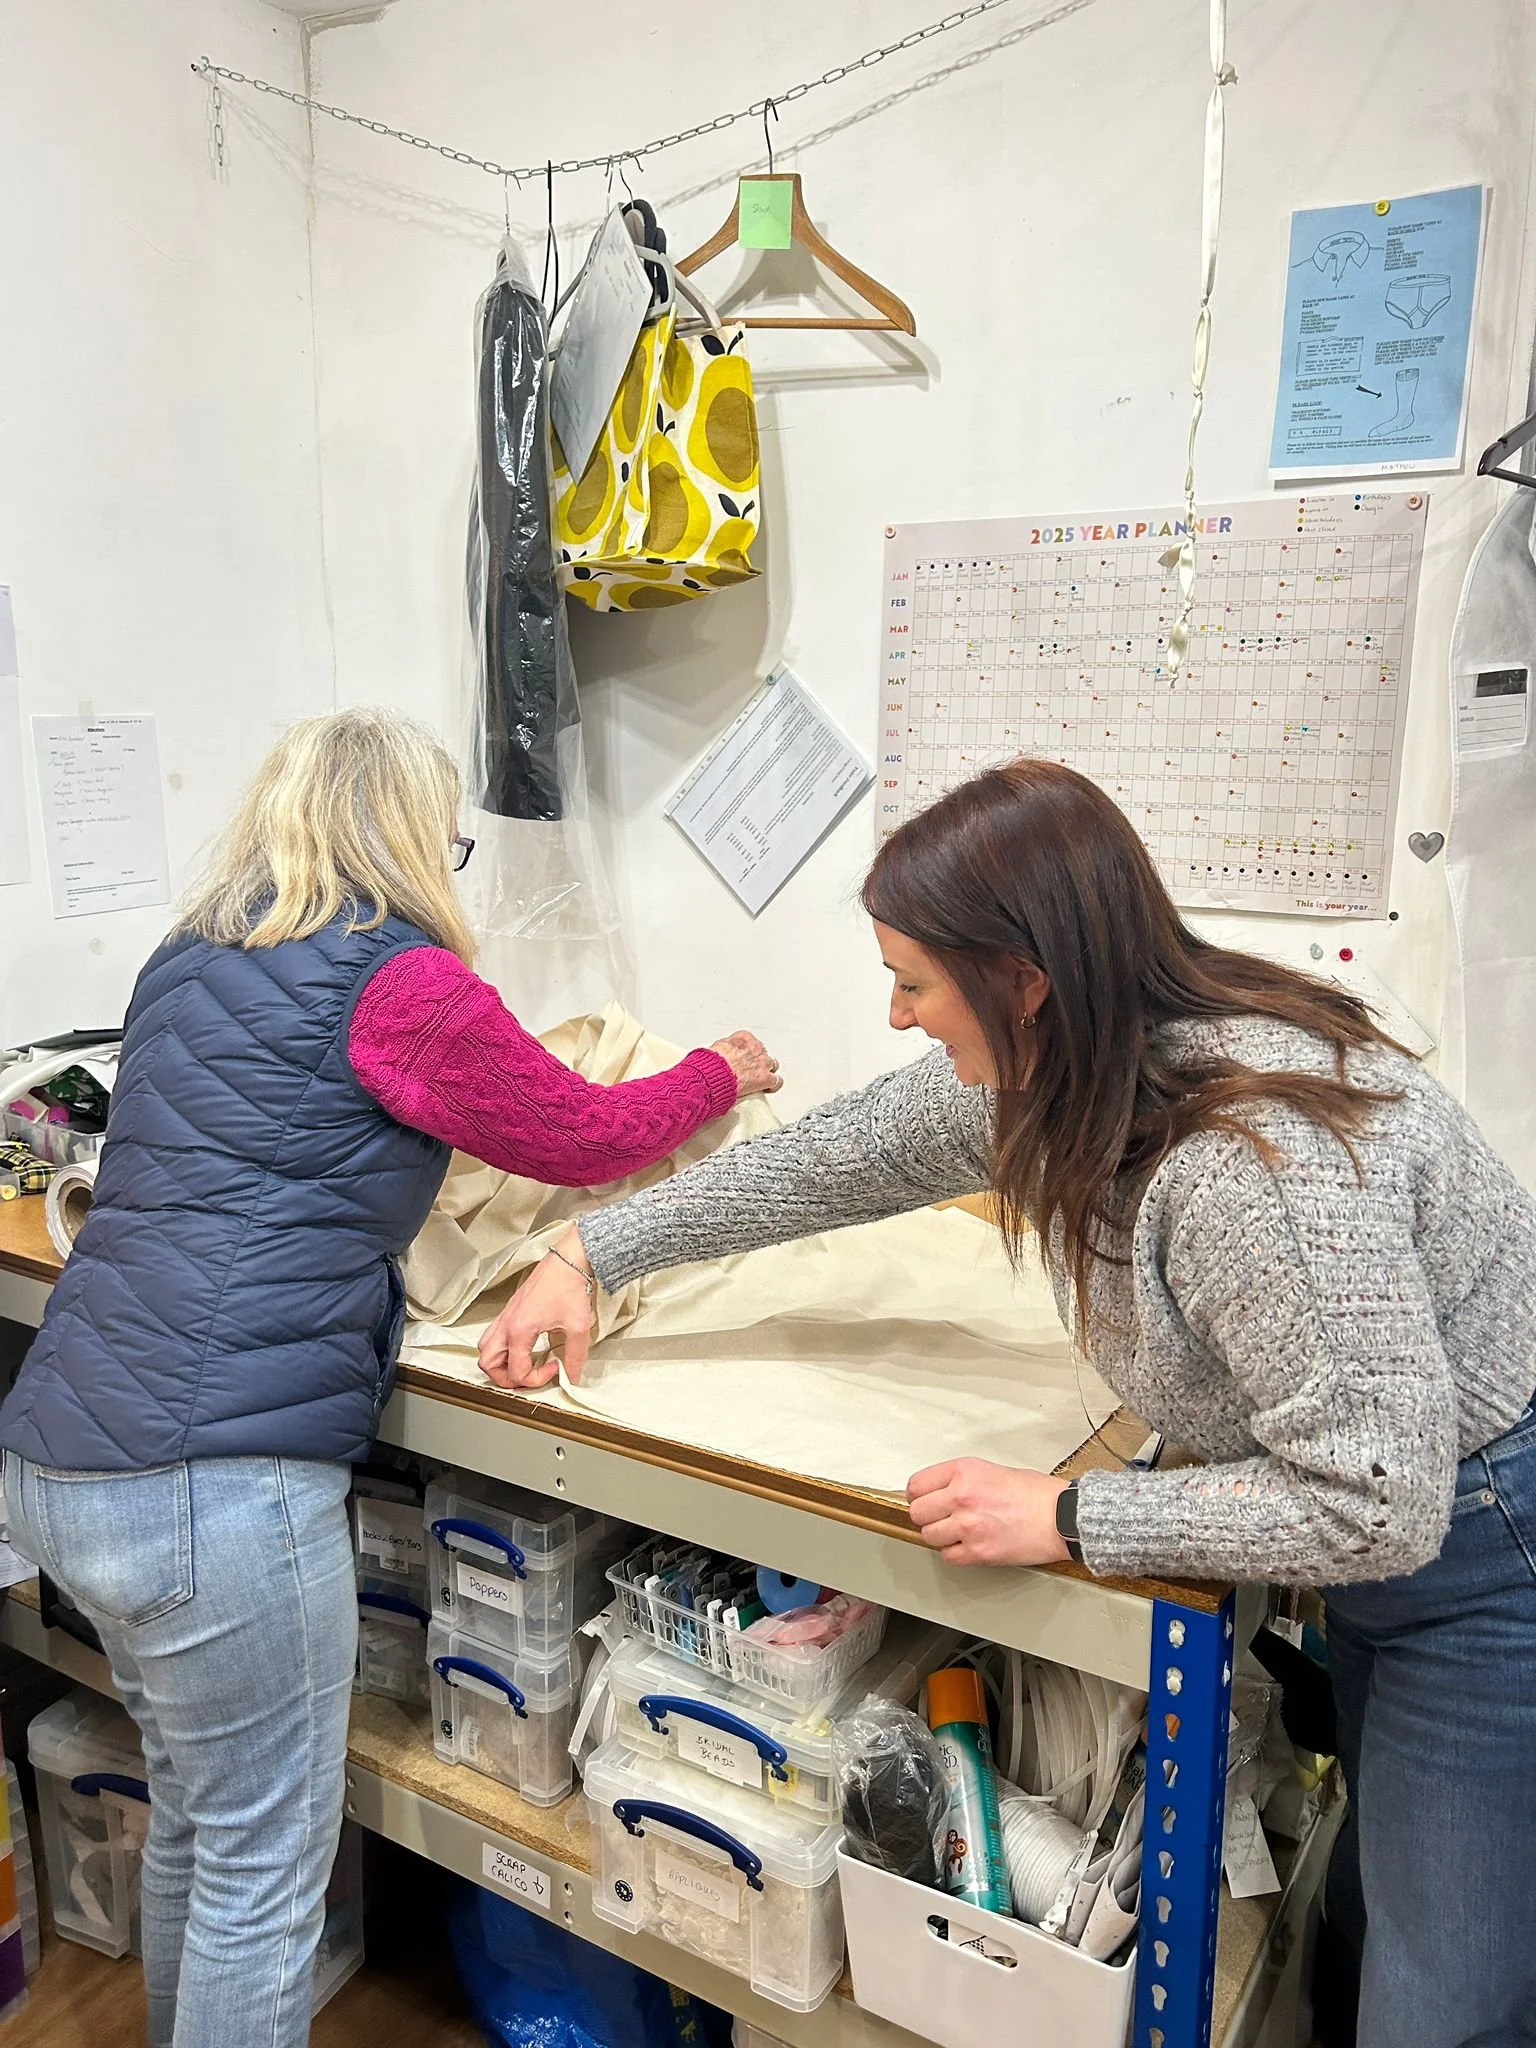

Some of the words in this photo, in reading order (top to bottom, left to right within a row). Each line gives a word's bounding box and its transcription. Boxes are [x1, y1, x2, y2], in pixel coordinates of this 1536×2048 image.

[1031, 527, 1074, 544] 2025
[1080, 523, 1130, 541] YEAR
[1134, 516, 1233, 538] PLANNER
[891, 573, 909, 581] JAN
[891, 599, 906, 607] FEB
[890, 625, 909, 633] MAR
[889, 652, 905, 660] APR
[888, 677, 907, 686] MAY
[886, 703, 903, 711] JUN
[885, 729, 900, 737] JUL
[885, 754, 902, 763] AUG
[884, 780, 897, 788] SEP
[883, 805, 899, 813] OCT
[1296, 899, 1314, 908] This
[1316, 900, 1324, 908] is
[1325, 901, 1346, 911] your
[470, 1576, 508, 1601] Poppers
[696, 1736, 735, 1755] BRIDAL
[700, 1747, 735, 1767] BEADS
[496, 1852, 526, 1874] SCRAP
[491, 1865, 528, 1892] CALICO
